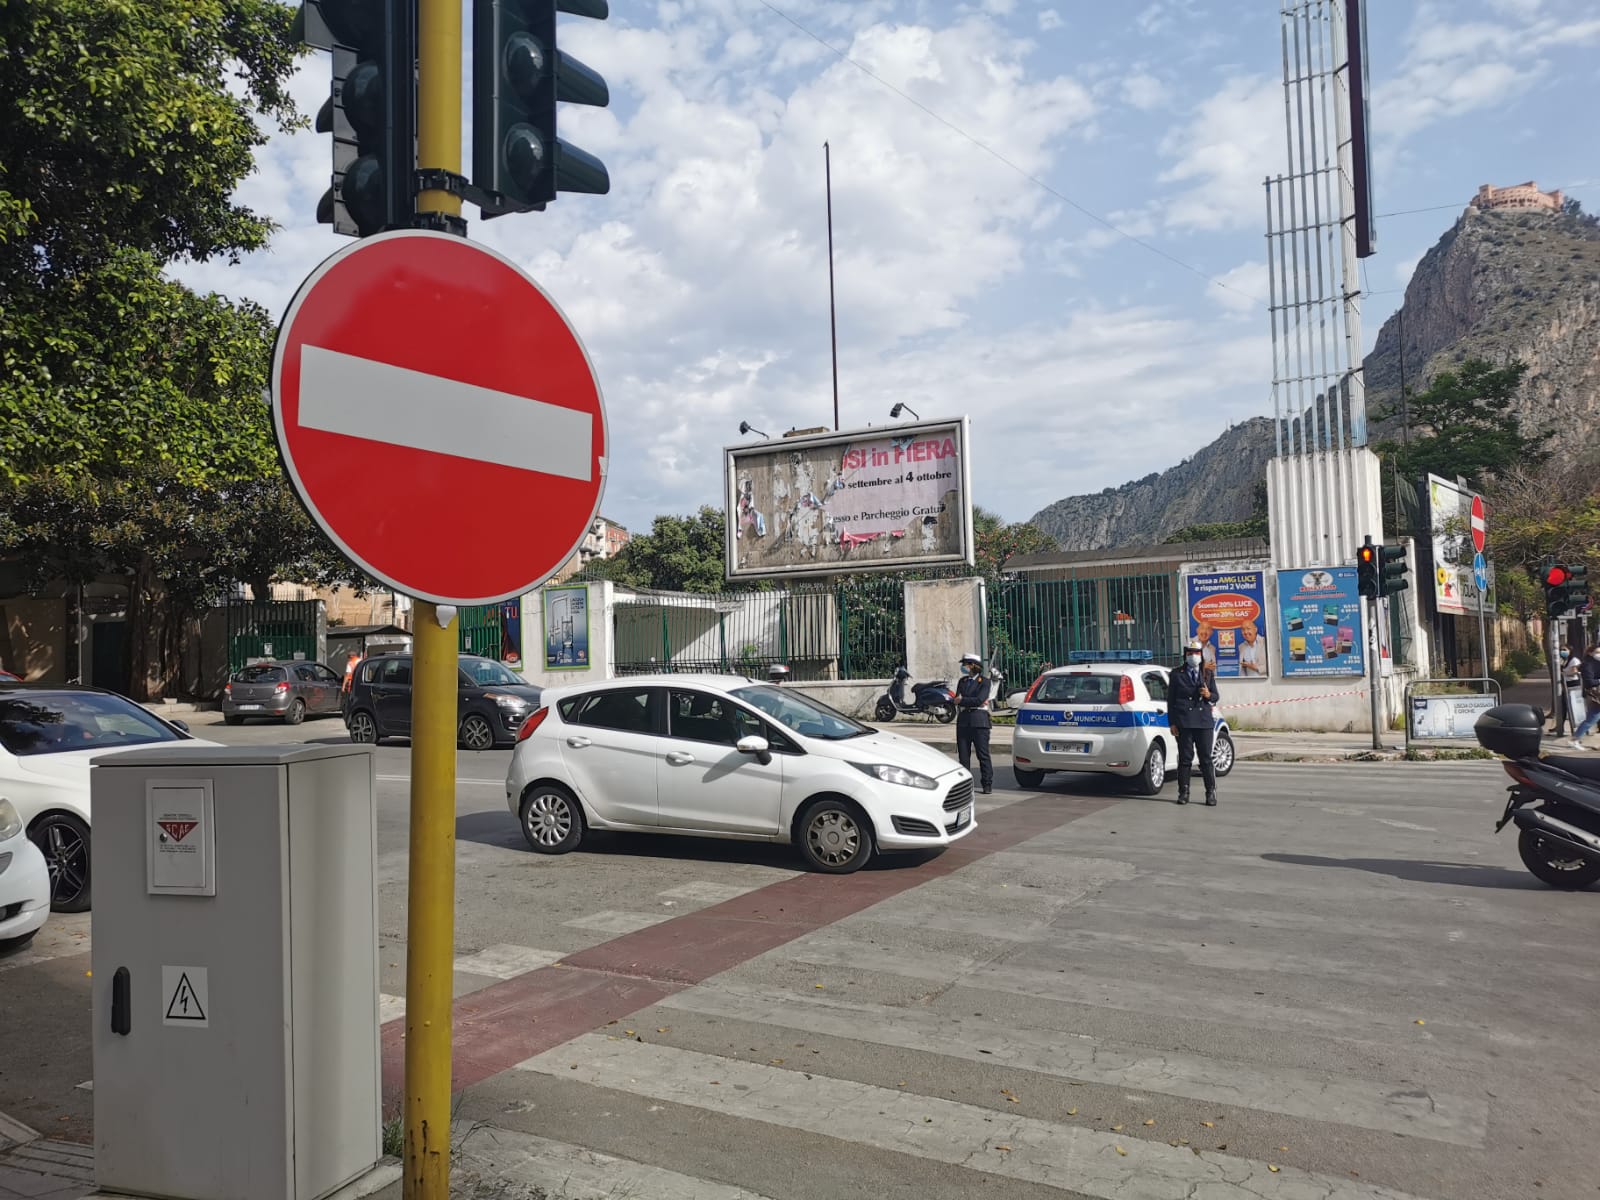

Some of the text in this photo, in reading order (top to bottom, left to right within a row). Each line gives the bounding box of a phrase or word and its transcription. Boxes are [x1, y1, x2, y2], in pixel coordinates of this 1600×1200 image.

[871, 447, 889, 467] in
[848, 477, 892, 489] settembre
[895, 475, 903, 485] al
[905, 471, 914, 482] 4
[916, 471, 952, 481] ottobre
[861, 508, 909, 521] Parcheggio
[1237, 575, 1256, 583] LUCE
[1200, 584, 1228, 592] risparmi
[1073, 715, 1117, 723] MUNICIPALE
